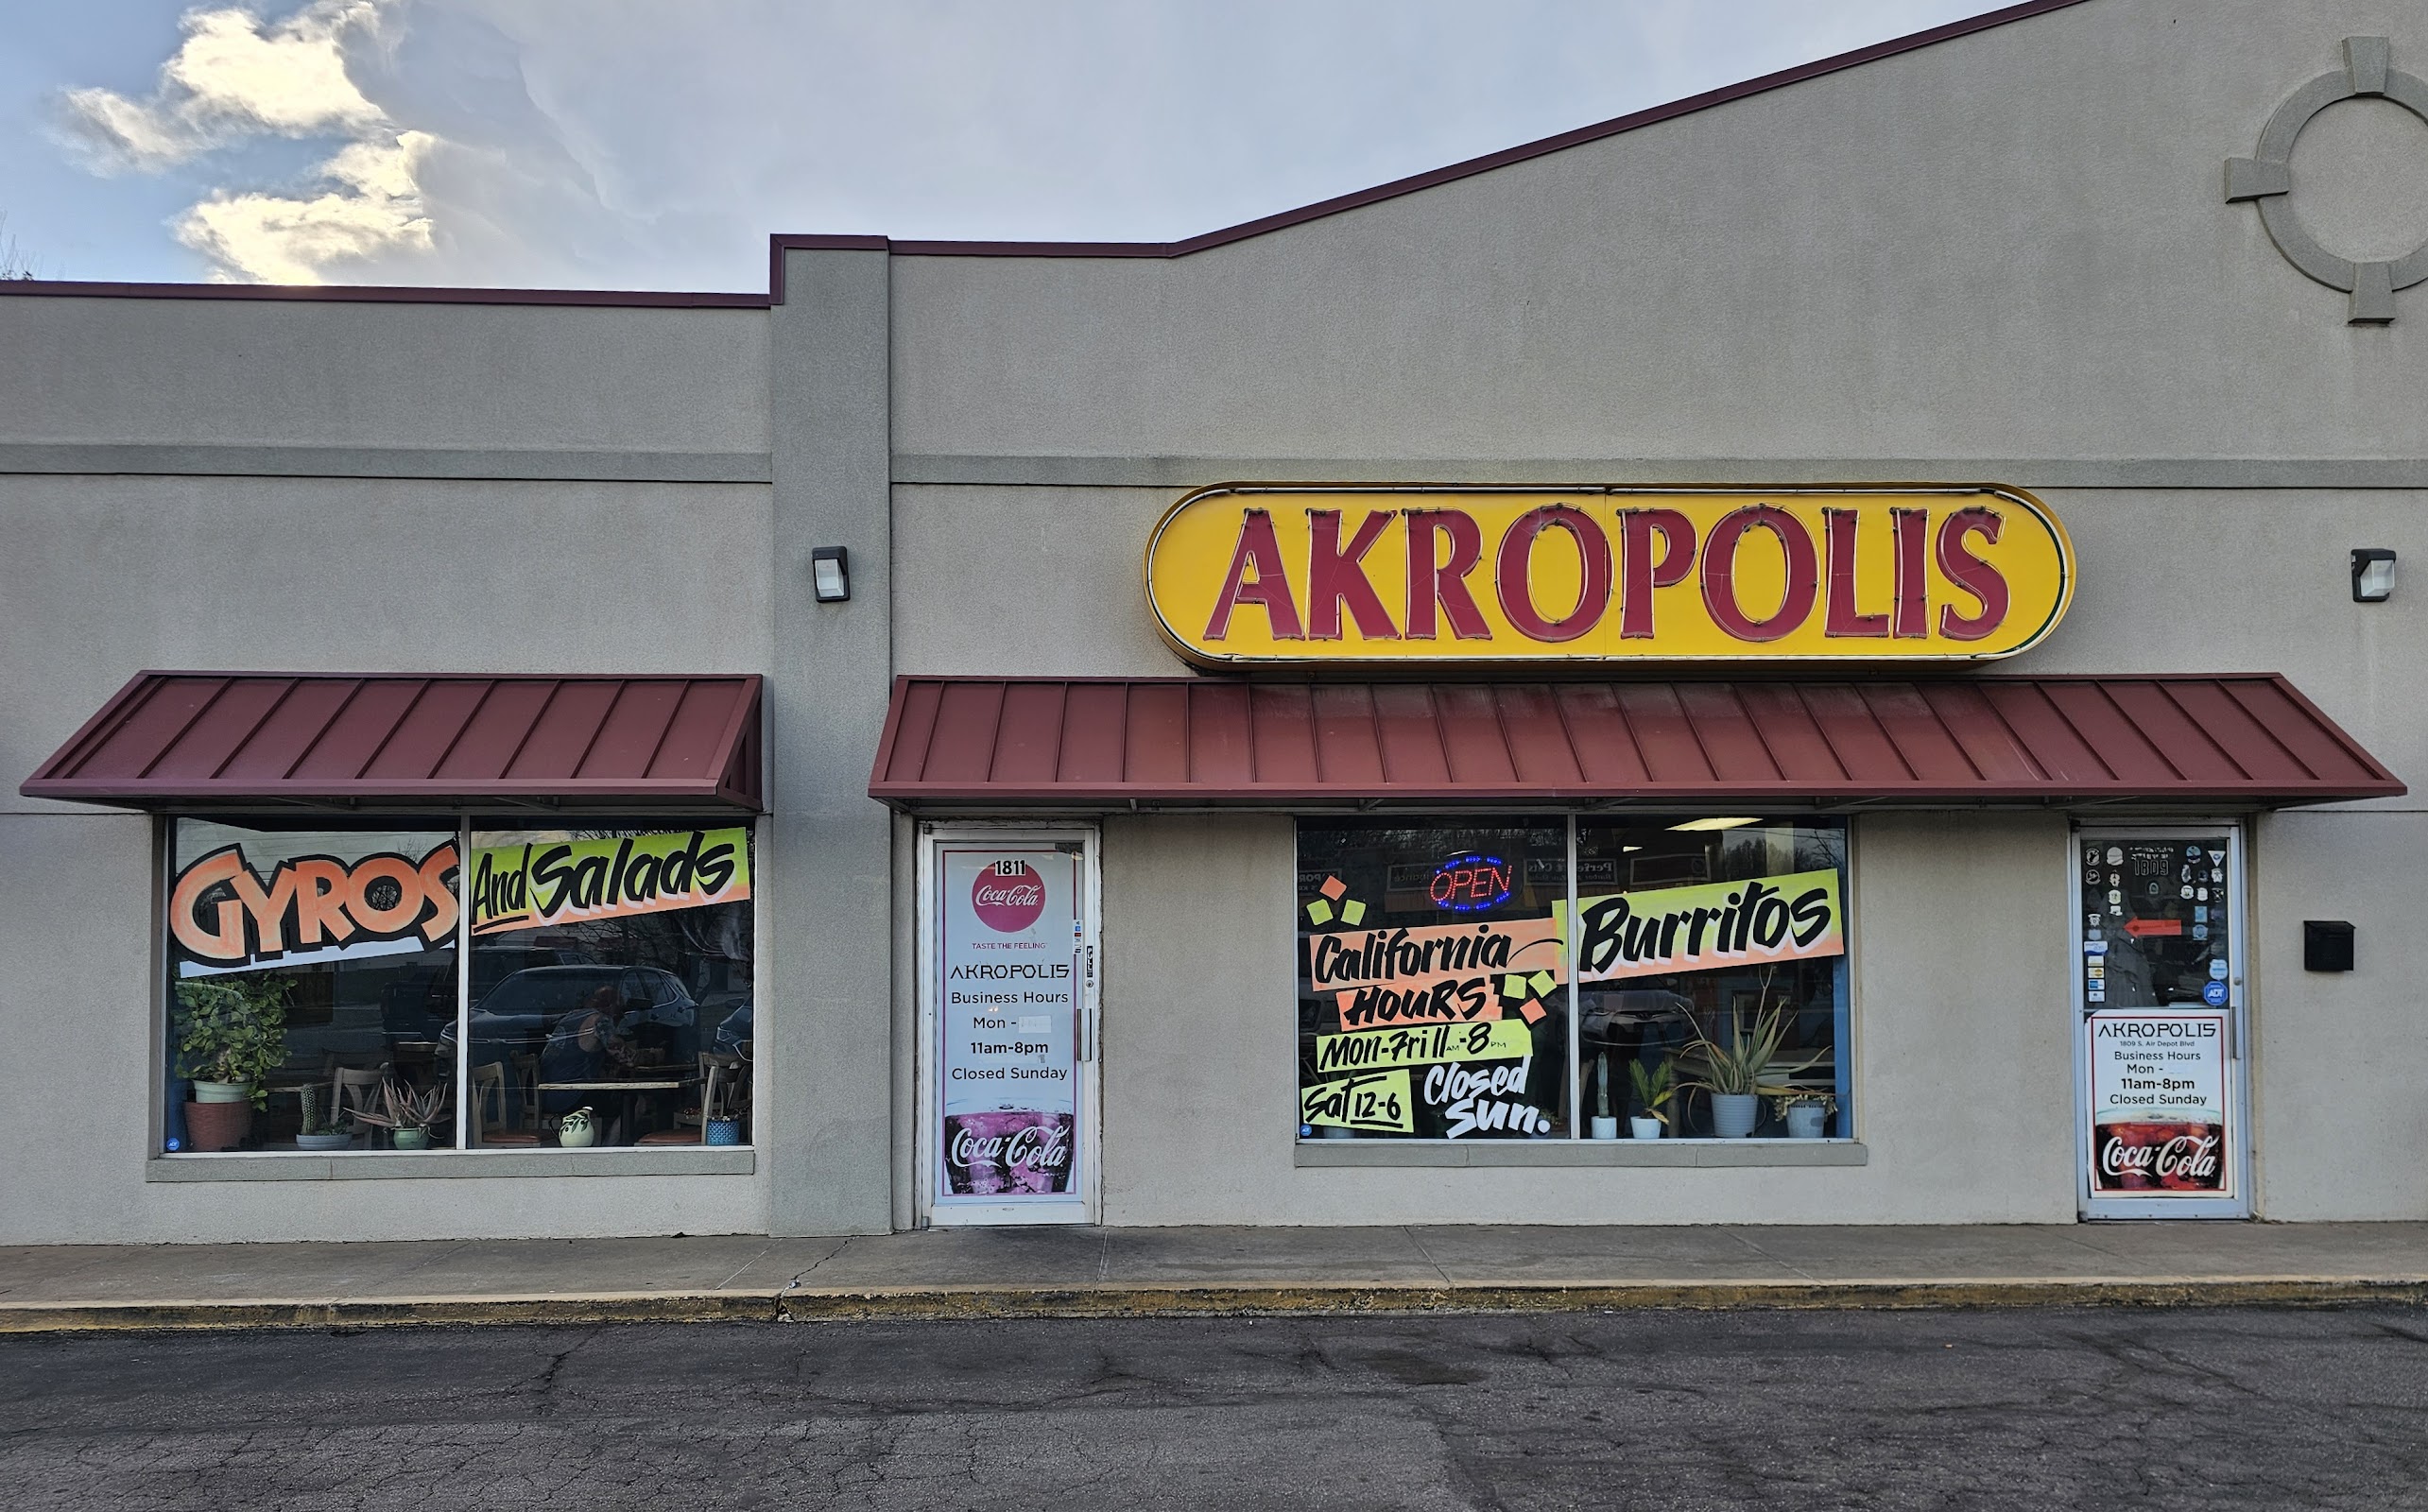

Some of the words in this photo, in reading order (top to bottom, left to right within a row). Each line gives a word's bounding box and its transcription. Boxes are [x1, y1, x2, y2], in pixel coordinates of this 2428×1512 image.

[1202, 503, 2012, 643] AKROPOLIS
[995, 860, 1025, 875] 1811
[2134, 859, 2169, 876] 1809
[1430, 865, 1512, 902] OPEN
[169, 841, 458, 965] GYROS
[473, 842, 534, 923] And
[530, 830, 735, 919] Salads
[975, 885, 1042, 906] Coca-Cola
[1315, 923, 1512, 984] California
[1578, 881, 1832, 974] Burritos
[950, 964, 1070, 980] AKROPOLIS
[951, 991, 1019, 1004] Business
[1024, 991, 1069, 1004] Hours
[2207, 988, 2225, 998] ADT
[973, 1017, 1007, 1029] Mon
[2098, 1022, 2216, 1039] AKROPOLIS
[970, 1041, 1049, 1056] 11am-8pm
[2114, 1051, 2164, 1060] Business
[2167, 1051, 2201, 1060] Hours
[951, 1067, 1006, 1080] Closed
[1010, 1067, 1069, 1081] Sunday
[2127, 1063, 2155, 1074] Mon
[1422, 1055, 1532, 1106] Closed
[2121, 1078, 2196, 1091] 11am-8pm
[1354, 1091, 1402, 1122] 12-6
[2109, 1094, 2155, 1105] Closed
[2159, 1094, 2207, 1107] Sunday
[951, 1125, 1070, 1169] Coca-Cola
[2102, 1135, 2220, 1177] Coca-Cola
